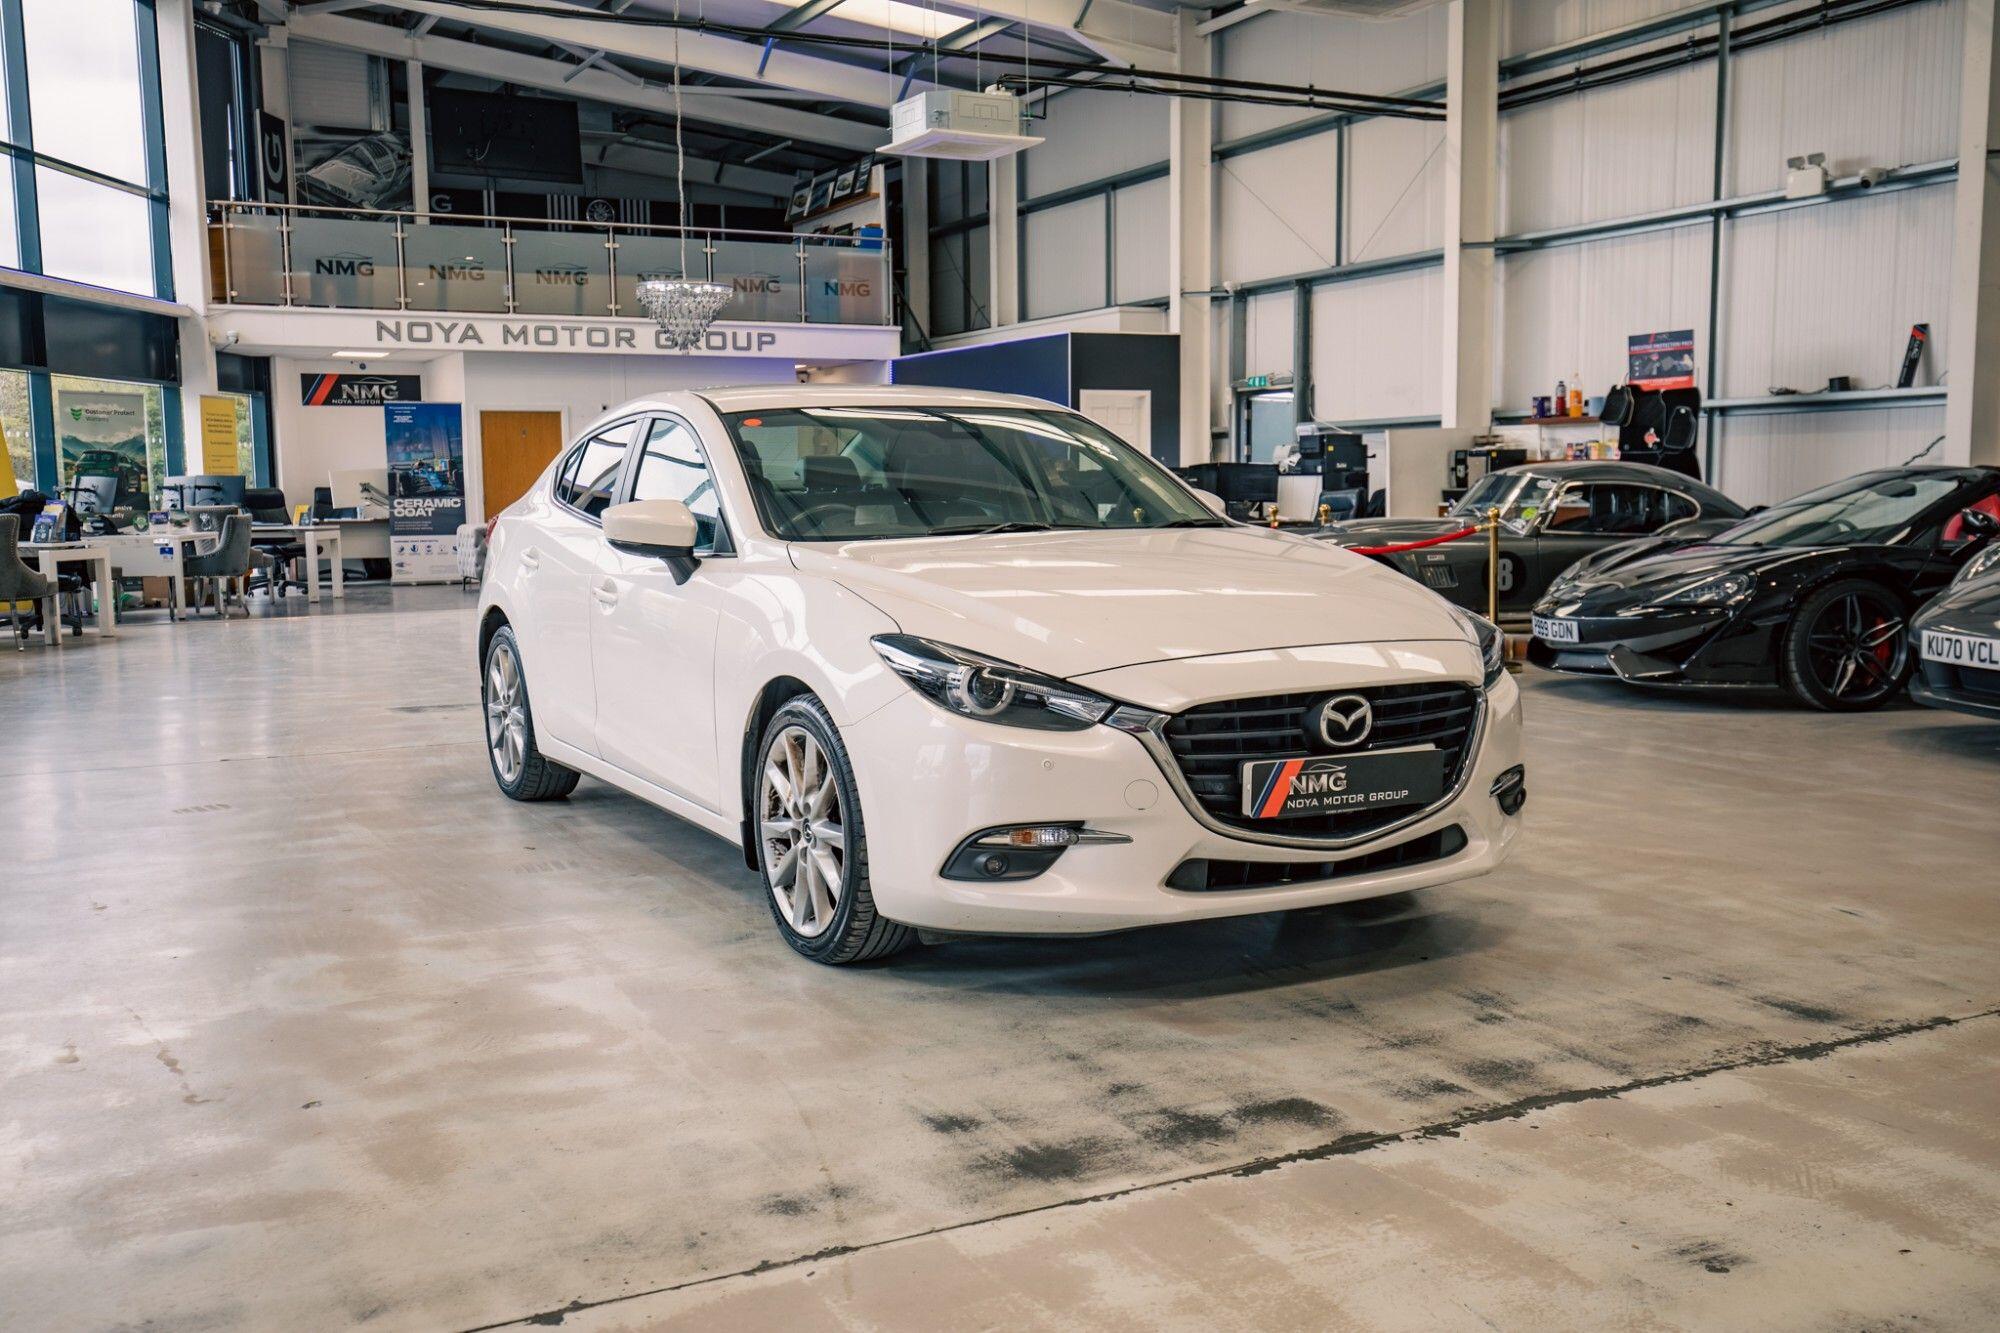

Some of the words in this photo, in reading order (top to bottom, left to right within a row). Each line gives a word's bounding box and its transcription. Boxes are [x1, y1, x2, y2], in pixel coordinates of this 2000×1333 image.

[315, 259, 374, 276] NMG
[429, 264, 485, 281] NMG
[536, 269, 589, 286] NMG
[732, 278, 781, 294] NMG
[824, 281, 870, 297] NMG
[376, 320, 483, 344] NOYA
[503, 324, 636, 348] MOTOR
[655, 327, 776, 352] GOUP
[341, 384, 399, 400] NMG
[393, 498, 461, 508] CERAMIC
[394, 508, 435, 517] COAT
[1551, 621, 1573, 640] GDN
[1928, 635, 1963, 660] KU70
[1967, 640, 1999, 665] VCL
[1288, 771, 1347, 796] NMG
[1286, 797, 1319, 809] NOYA
[1323, 793, 1364, 806] MOTOR
[1369, 789, 1409, 802] GROUP
